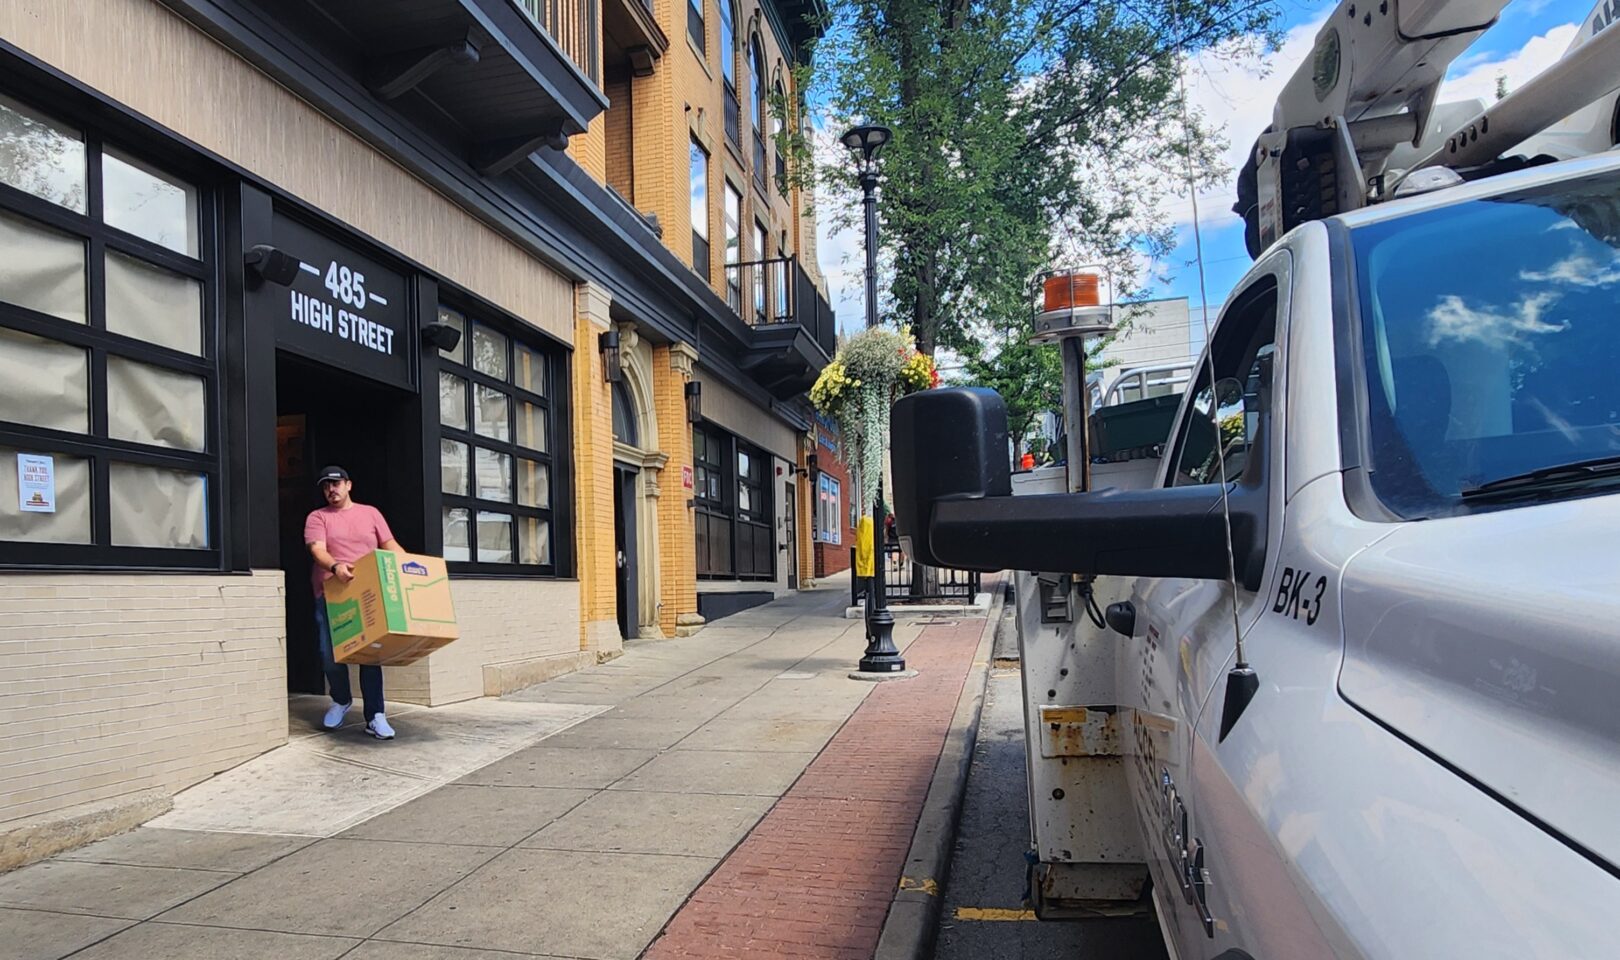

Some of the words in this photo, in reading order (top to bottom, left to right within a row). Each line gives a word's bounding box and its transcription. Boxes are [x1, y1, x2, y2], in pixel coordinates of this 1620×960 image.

[291, 290, 333, 334] HIGH
[338, 309, 394, 355] STREET
[1273, 566, 1327, 626] BK-3
